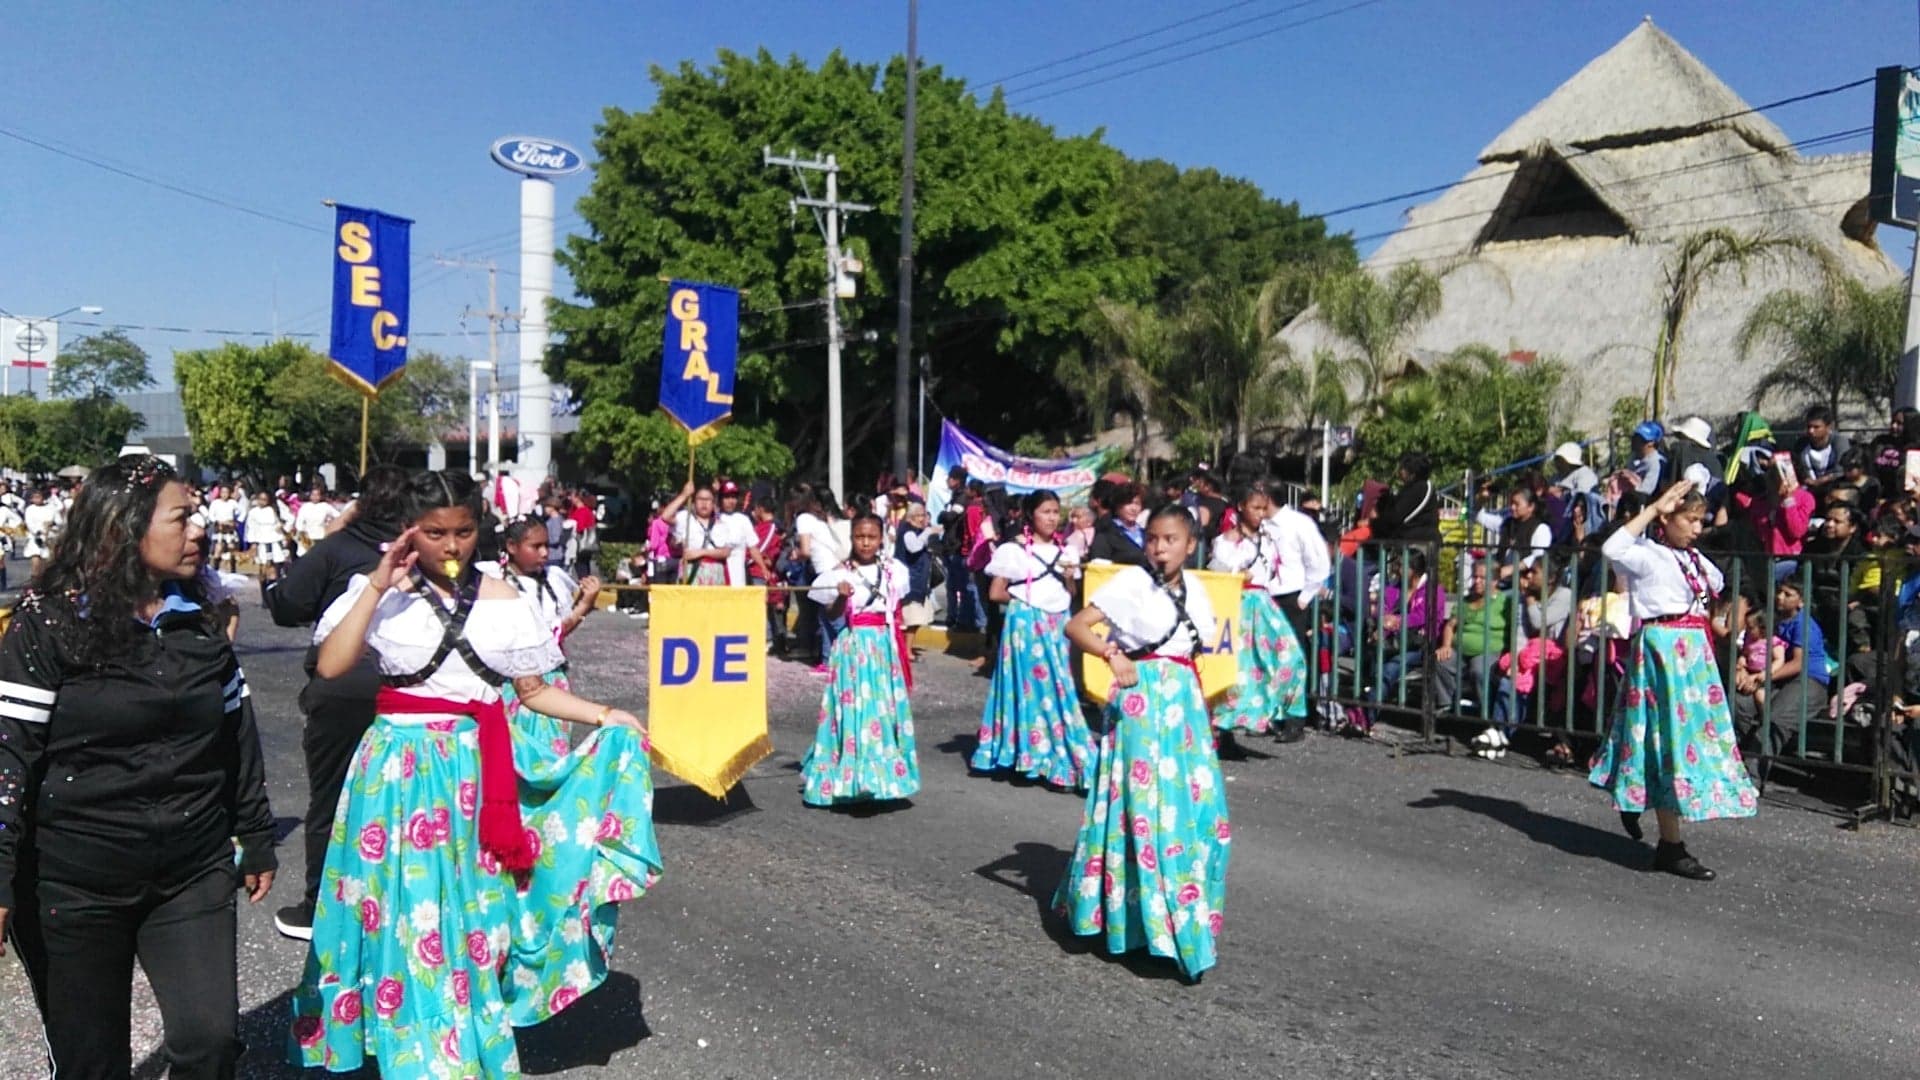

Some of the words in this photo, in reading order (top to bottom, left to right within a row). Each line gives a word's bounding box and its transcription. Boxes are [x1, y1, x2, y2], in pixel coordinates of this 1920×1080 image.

[512, 142, 567, 169] Ford
[338, 221, 408, 351] SEC.
[671, 288, 734, 405] GRAL
[660, 634, 749, 686] DE
